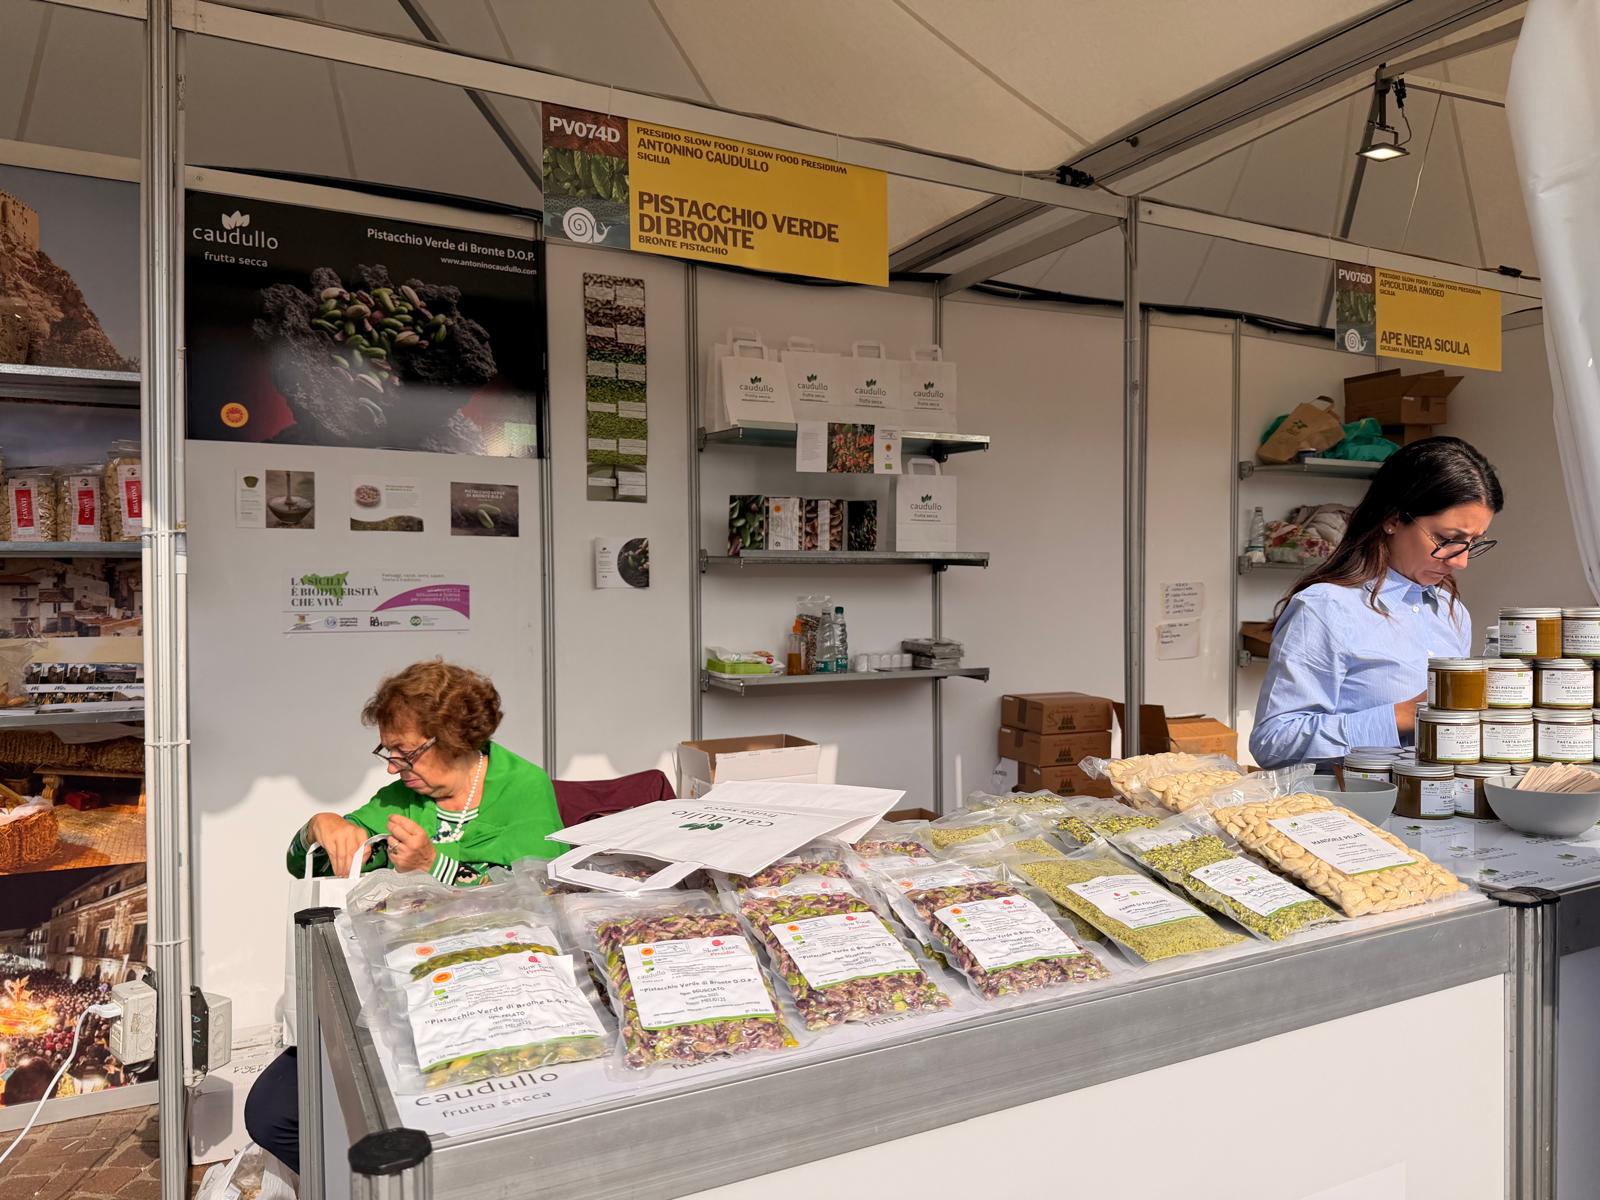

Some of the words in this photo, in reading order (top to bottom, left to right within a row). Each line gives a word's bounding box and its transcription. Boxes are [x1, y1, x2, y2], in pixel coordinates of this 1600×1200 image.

[549, 116, 621, 143] PV074D
[637, 127, 682, 142] PRESIDIO
[684, 135, 712, 148] SLOW
[714, 141, 739, 153] FOOD
[747, 148, 773, 161] SLOW
[776, 153, 800, 165] FOOD
[801, 159, 847, 175] PRESIDIUM
[637, 138, 704, 160] ANTONINO
[706, 151, 769, 173] CAUDULLO
[637, 152, 671, 166] SICILIA
[638, 191, 768, 230] PISTACCHIO
[772, 213, 839, 243] VERDE
[192, 226, 279, 250] caudullo
[639, 213, 665, 235] DI
[665, 217, 755, 250] BRONTE
[367, 227, 423, 247] Pistacchio
[424, 236, 456, 251] Verde
[457, 240, 469, 253] di
[470, 242, 505, 258] Bronte
[507, 248, 536, 262] D.O.P.
[638, 234, 678, 249] BRONTE
[680, 239, 729, 256] PISTACHIO
[204, 250, 236, 265] frutta
[238, 256, 268, 268] secca
[440, 256, 537, 276] www.antoninocaudullo.com
[1338, 268, 1373, 285] PV076D
[1379, 272, 1401, 280] PRESIDIO
[1401, 275, 1415, 283] SLOW
[1415, 278, 1428, 286] FOOD
[1431, 281, 1445, 289] SLOW
[1445, 284, 1458, 292] FOOD
[1457, 286, 1482, 296] PRESIDIUM
[1379, 288, 1396, 297] SICILIA
[1380, 279, 1418, 293] APICOLTURA
[1418, 286, 1445, 298] AMODEO
[1380, 330, 1402, 346] APE
[1403, 333, 1433, 351] NERA
[1435, 338, 1471, 356] SICULA
[739, 383, 774, 393] caudullo
[797, 382, 828, 392] caudullo
[854, 387, 887, 397] caudullo
[913, 389, 944, 400] caudullo
[910, 502, 942, 512] caudullo
[306, 577, 349, 586] SICILIA
[300, 585, 379, 597] BIODIVERSITÀ
[291, 598, 316, 607] CHE
[317, 598, 344, 607] VIVE
[672, 810, 774, 827] caudullo
[477, 1005, 504, 1015] Verde
[506, 1003, 514, 1011] di
[863, 1016, 905, 1028] frutta
[415, 1072, 559, 1107] caudullo
[442, 1101, 496, 1119] frutta
[502, 1091, 552, 1106] secca
